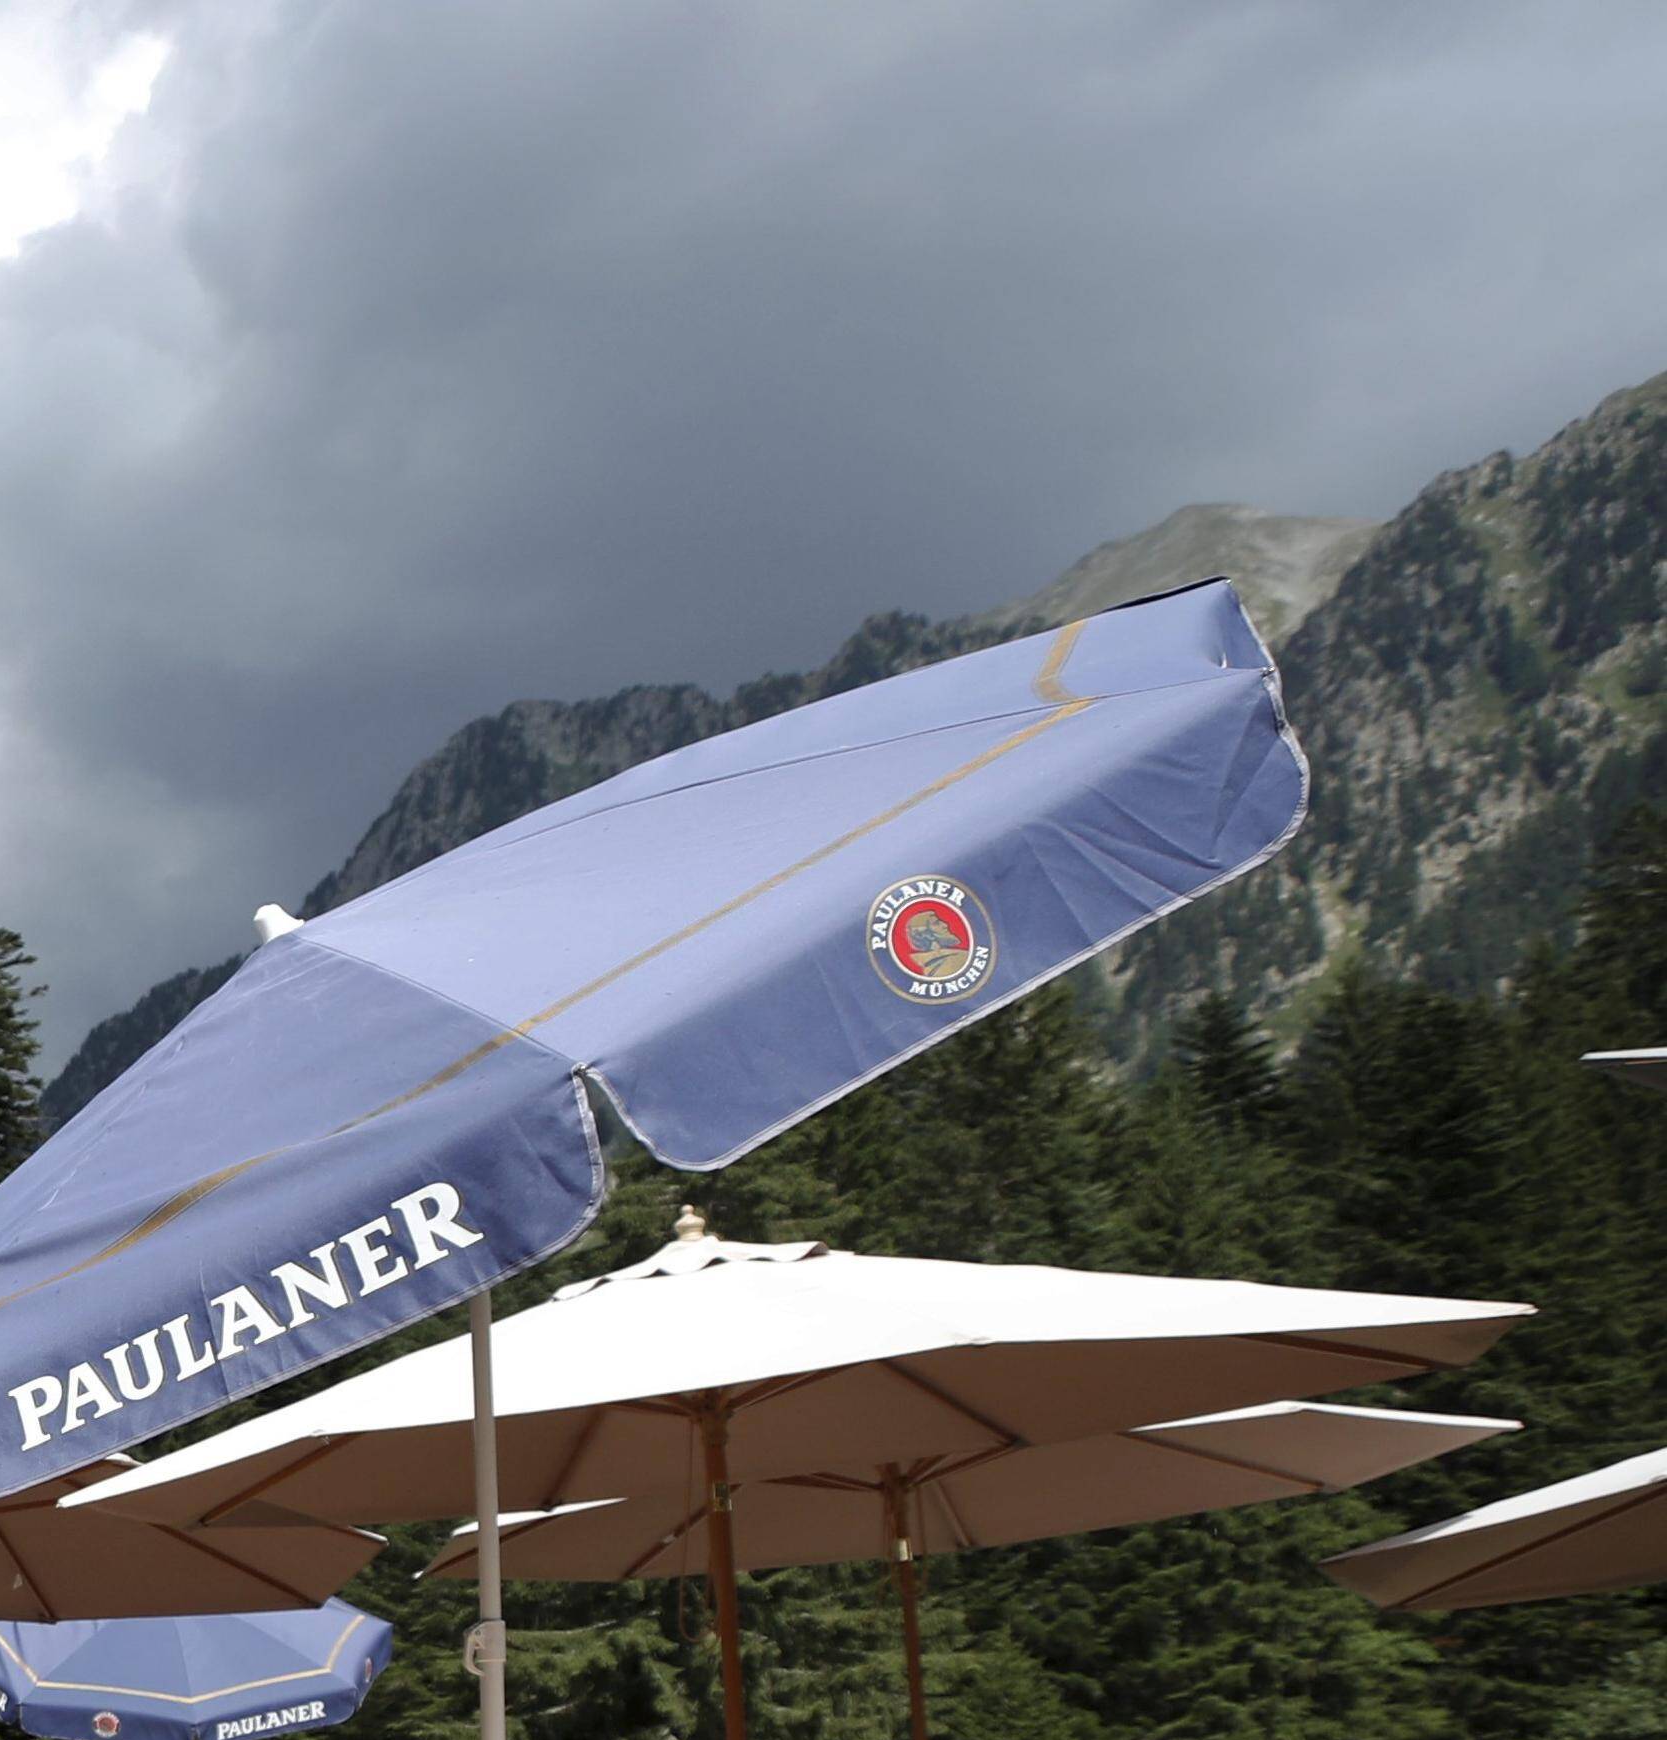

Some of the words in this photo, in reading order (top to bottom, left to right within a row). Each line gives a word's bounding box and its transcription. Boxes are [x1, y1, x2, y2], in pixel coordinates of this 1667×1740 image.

[871, 880, 966, 950] PAULANER
[909, 945, 989, 997] MÜNCHEN
[7, 1182, 484, 1452] PAULANER
[217, 1701, 327, 1740] PAULANER
